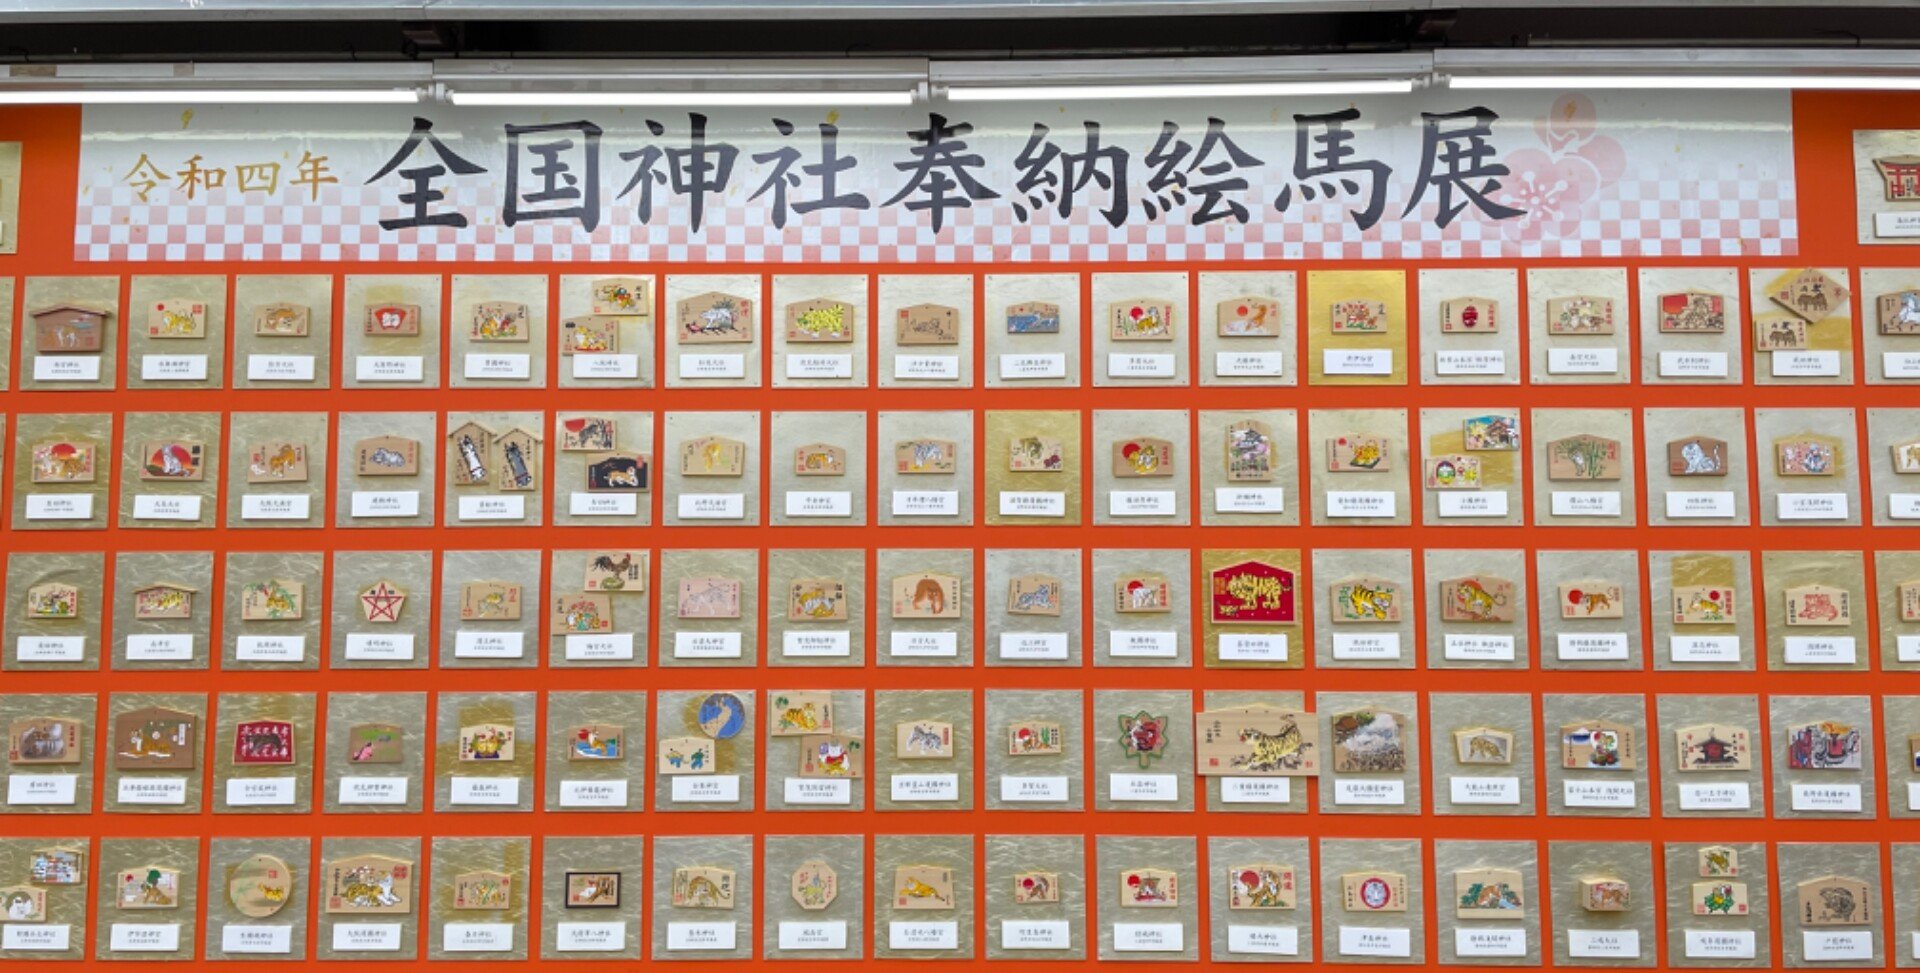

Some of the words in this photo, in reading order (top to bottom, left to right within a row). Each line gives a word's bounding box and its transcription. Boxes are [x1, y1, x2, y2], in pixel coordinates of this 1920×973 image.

[122, 151, 340, 203] 令和四年
[364, 106, 1528, 234] 全国神社奉納絵馬展
